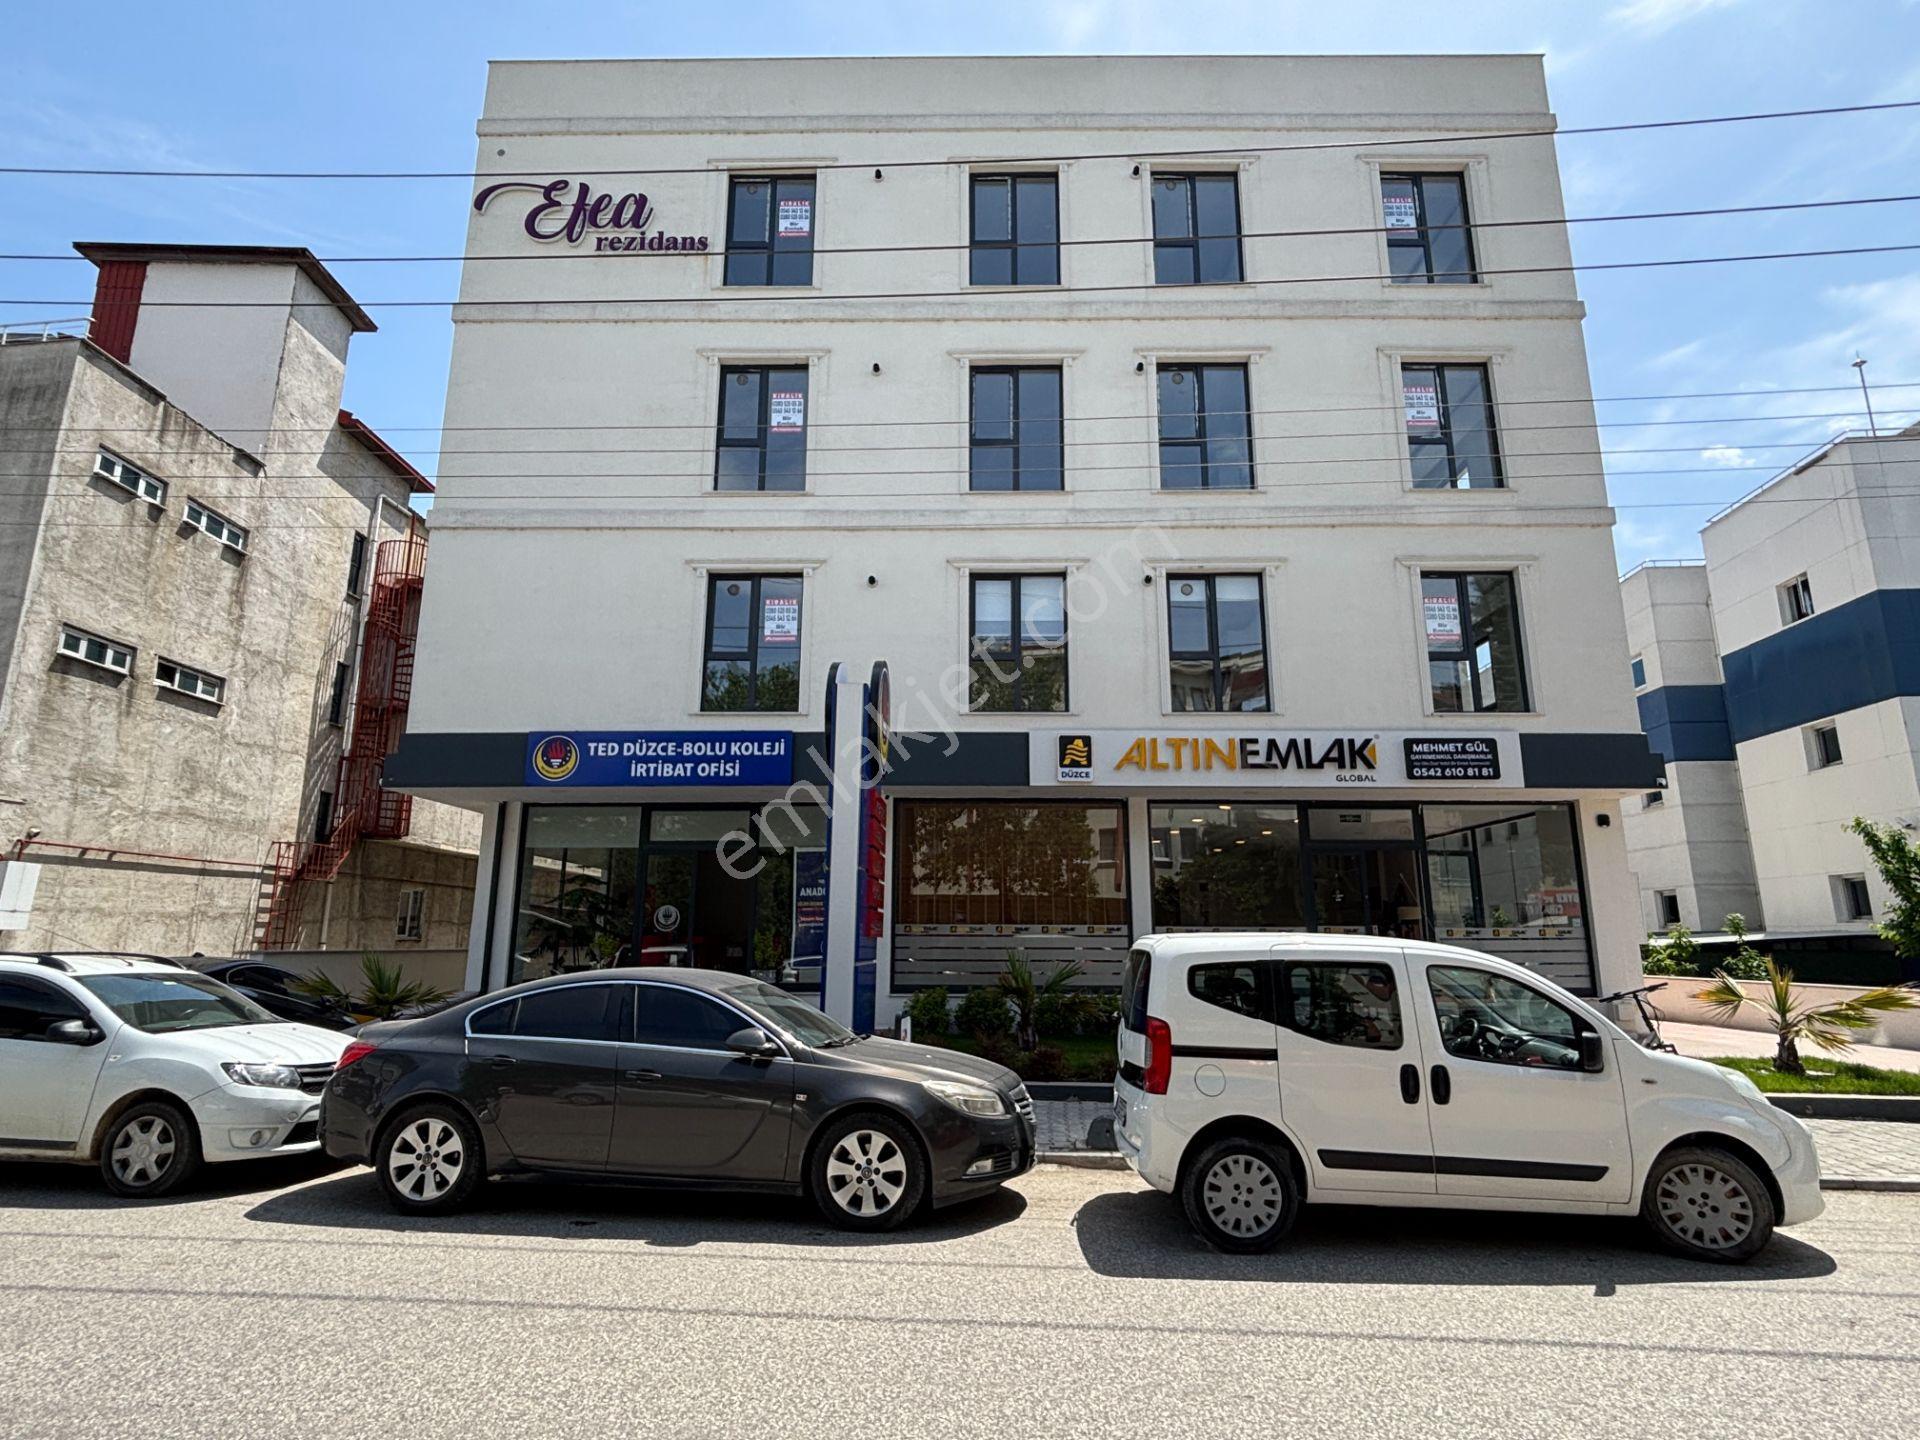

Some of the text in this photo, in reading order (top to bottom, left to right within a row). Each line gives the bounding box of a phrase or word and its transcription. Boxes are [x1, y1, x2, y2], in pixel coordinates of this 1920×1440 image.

[474, 179, 653, 243] Efea
[595, 231, 708, 251] rezidans
[588, 738, 785, 756] TED DÜZCE-BOLU KOLEJİ
[1412, 741, 1490, 753] MEHMET GÜL
[631, 759, 740, 777] İRTİBAT OFİSİ
[1061, 770, 1091, 779] DÜZCE
[1413, 767, 1494, 777] 0542 610 81 81
[1335, 774, 1377, 783] GLOBAL
